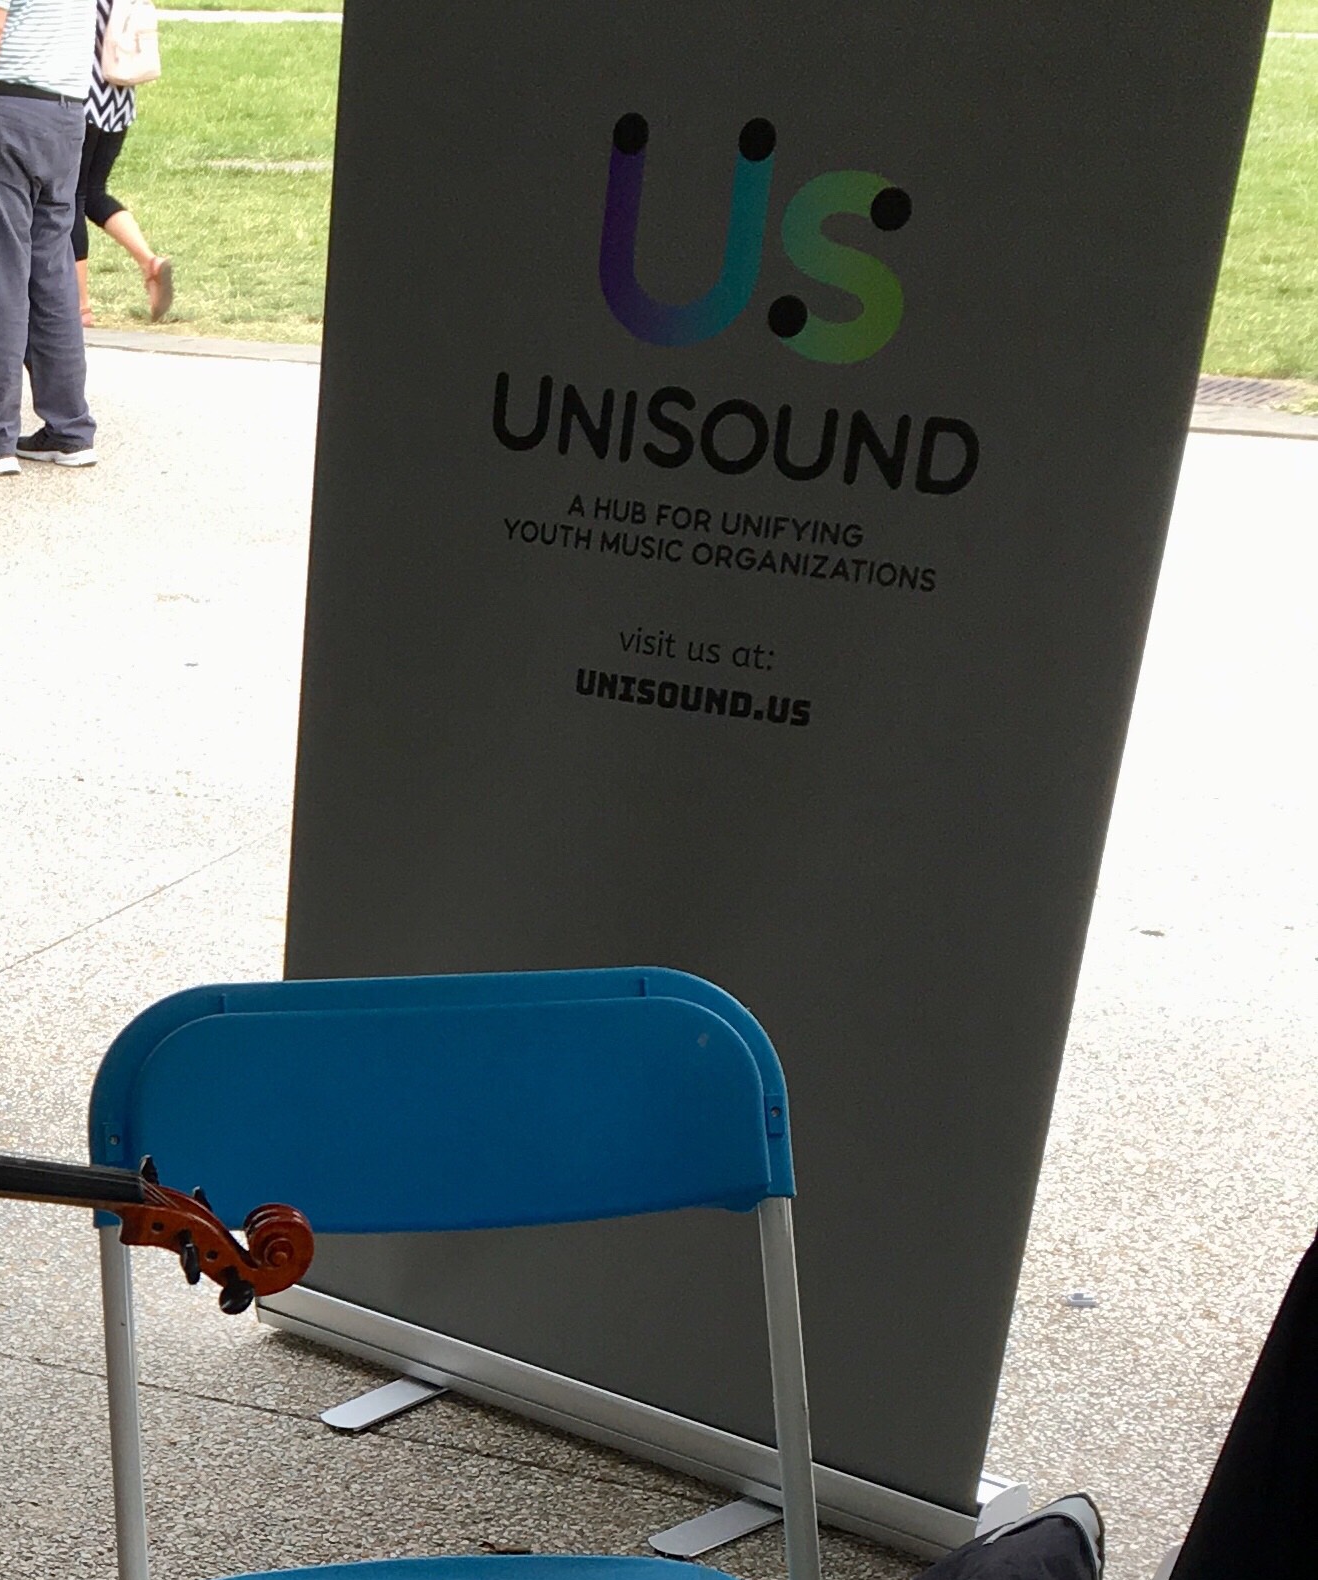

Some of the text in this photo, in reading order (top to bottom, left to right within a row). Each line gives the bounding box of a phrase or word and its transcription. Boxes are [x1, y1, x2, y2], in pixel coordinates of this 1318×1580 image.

[492, 371, 980, 496] UNISOUND
[568, 495, 864, 548] A HUB FOR UNIFYING
[503, 518, 936, 592] YOUTH MUSIC ORGANIZATIONS
[619, 626, 775, 671] visit us at:
[576, 668, 811, 727] UNISOUND.US
